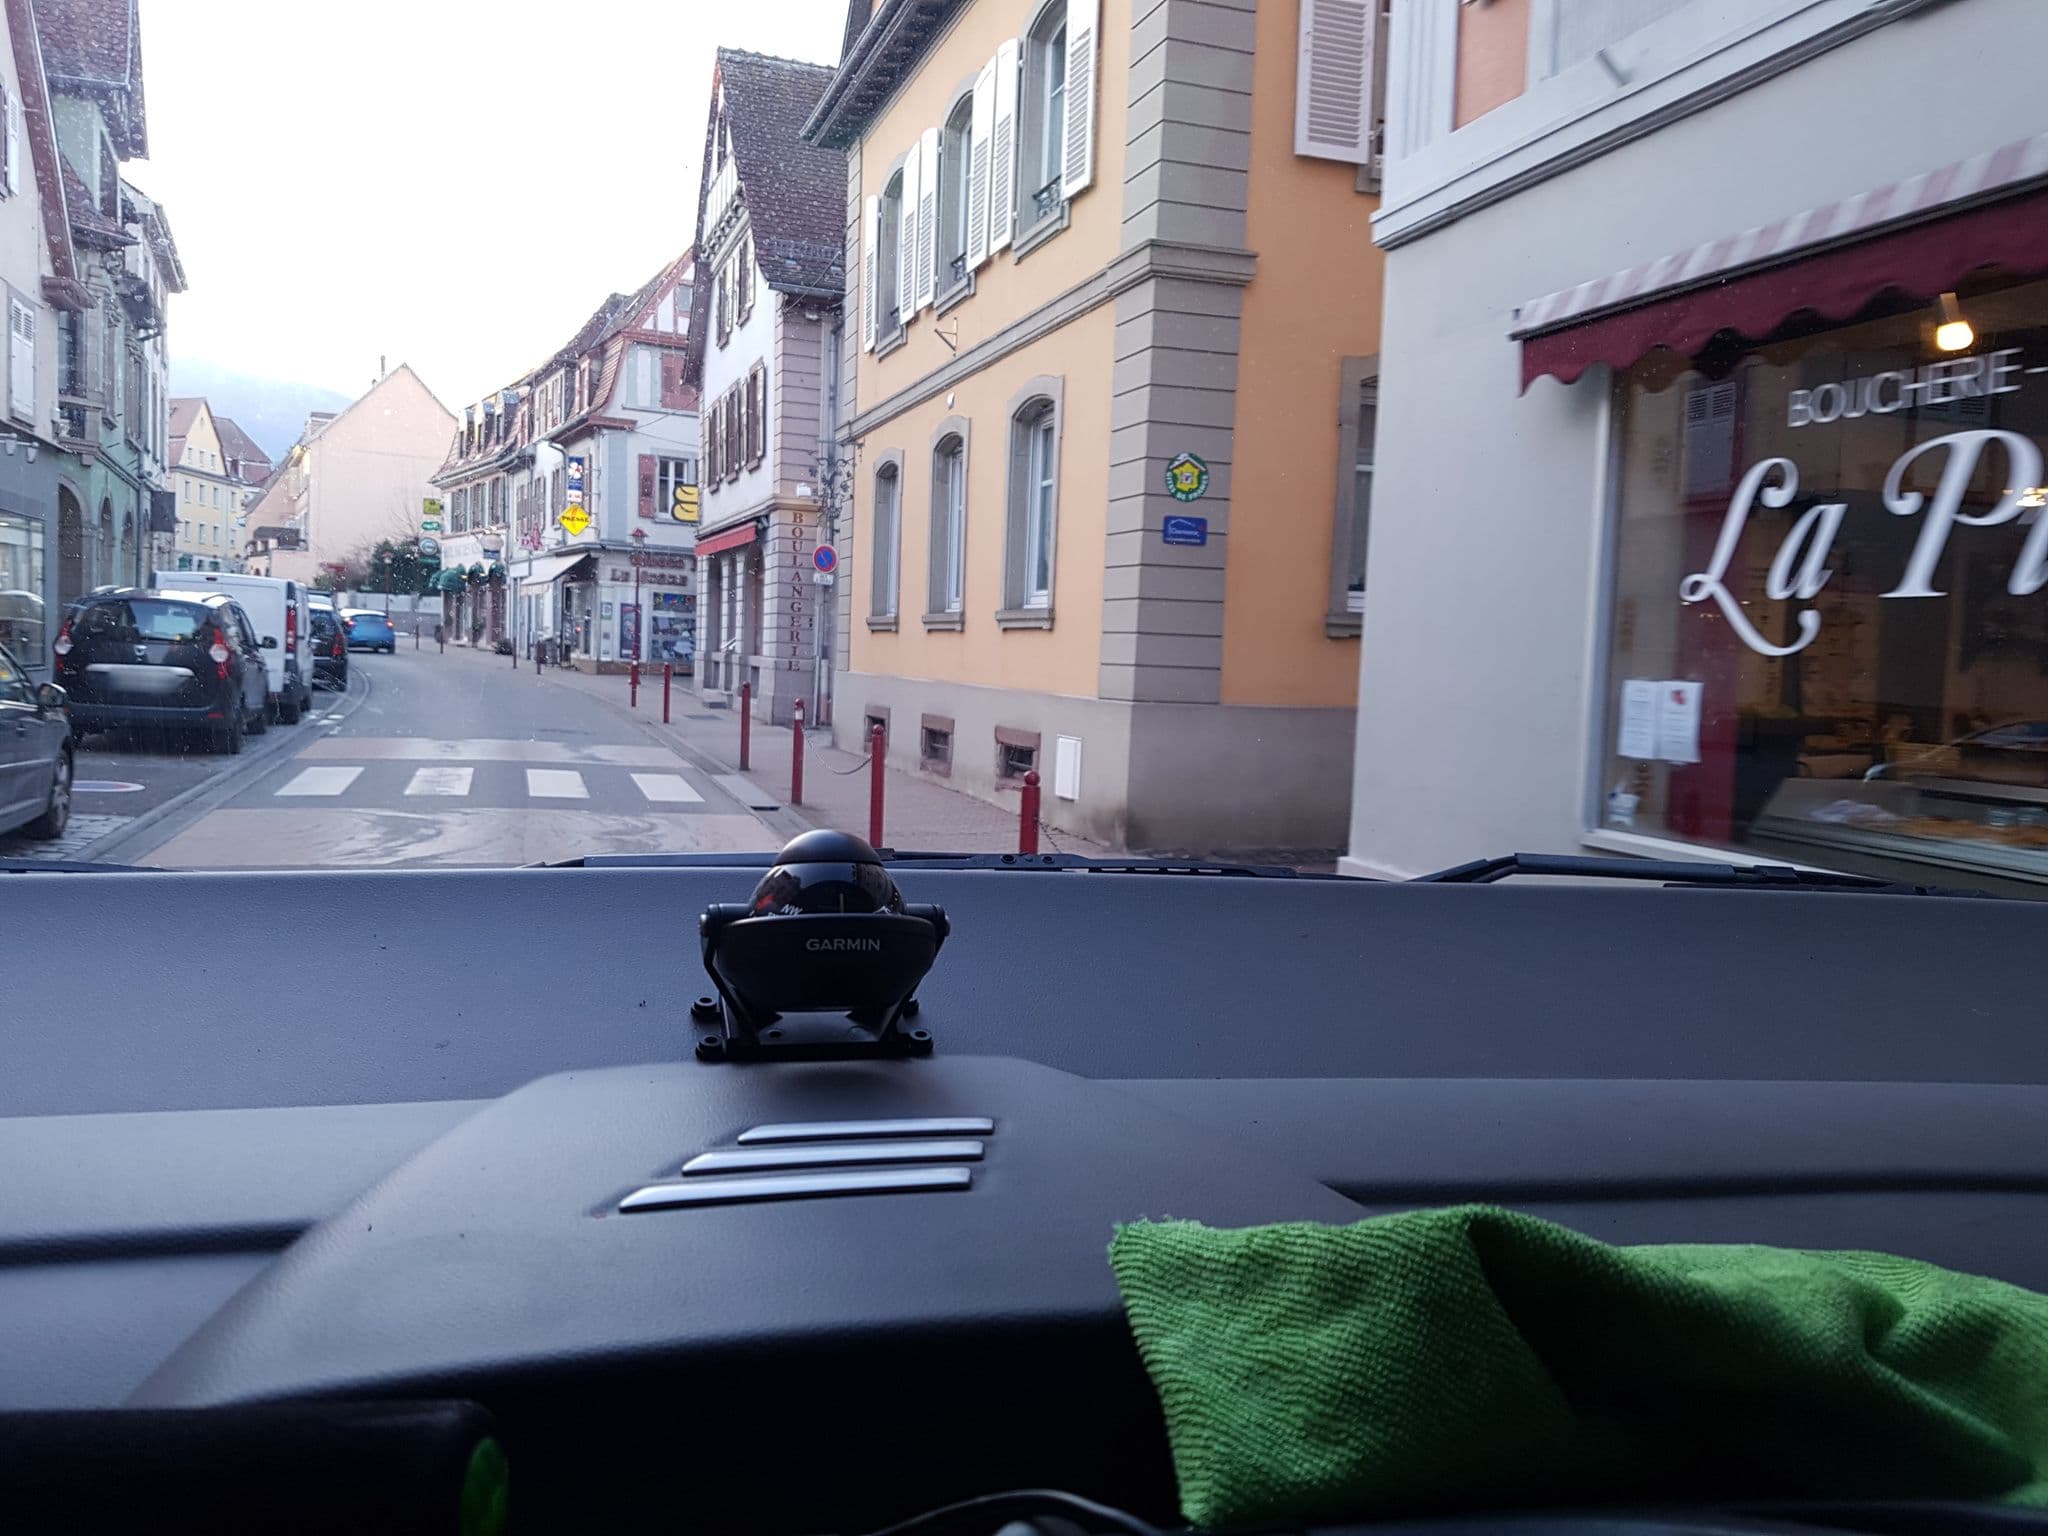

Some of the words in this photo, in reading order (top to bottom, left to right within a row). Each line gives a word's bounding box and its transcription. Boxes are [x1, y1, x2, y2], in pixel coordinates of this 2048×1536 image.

[787, 511, 804, 673] BOULANGERIE
[1679, 456, 1849, 657] La
[805, 938, 881, 952] GARMIN
